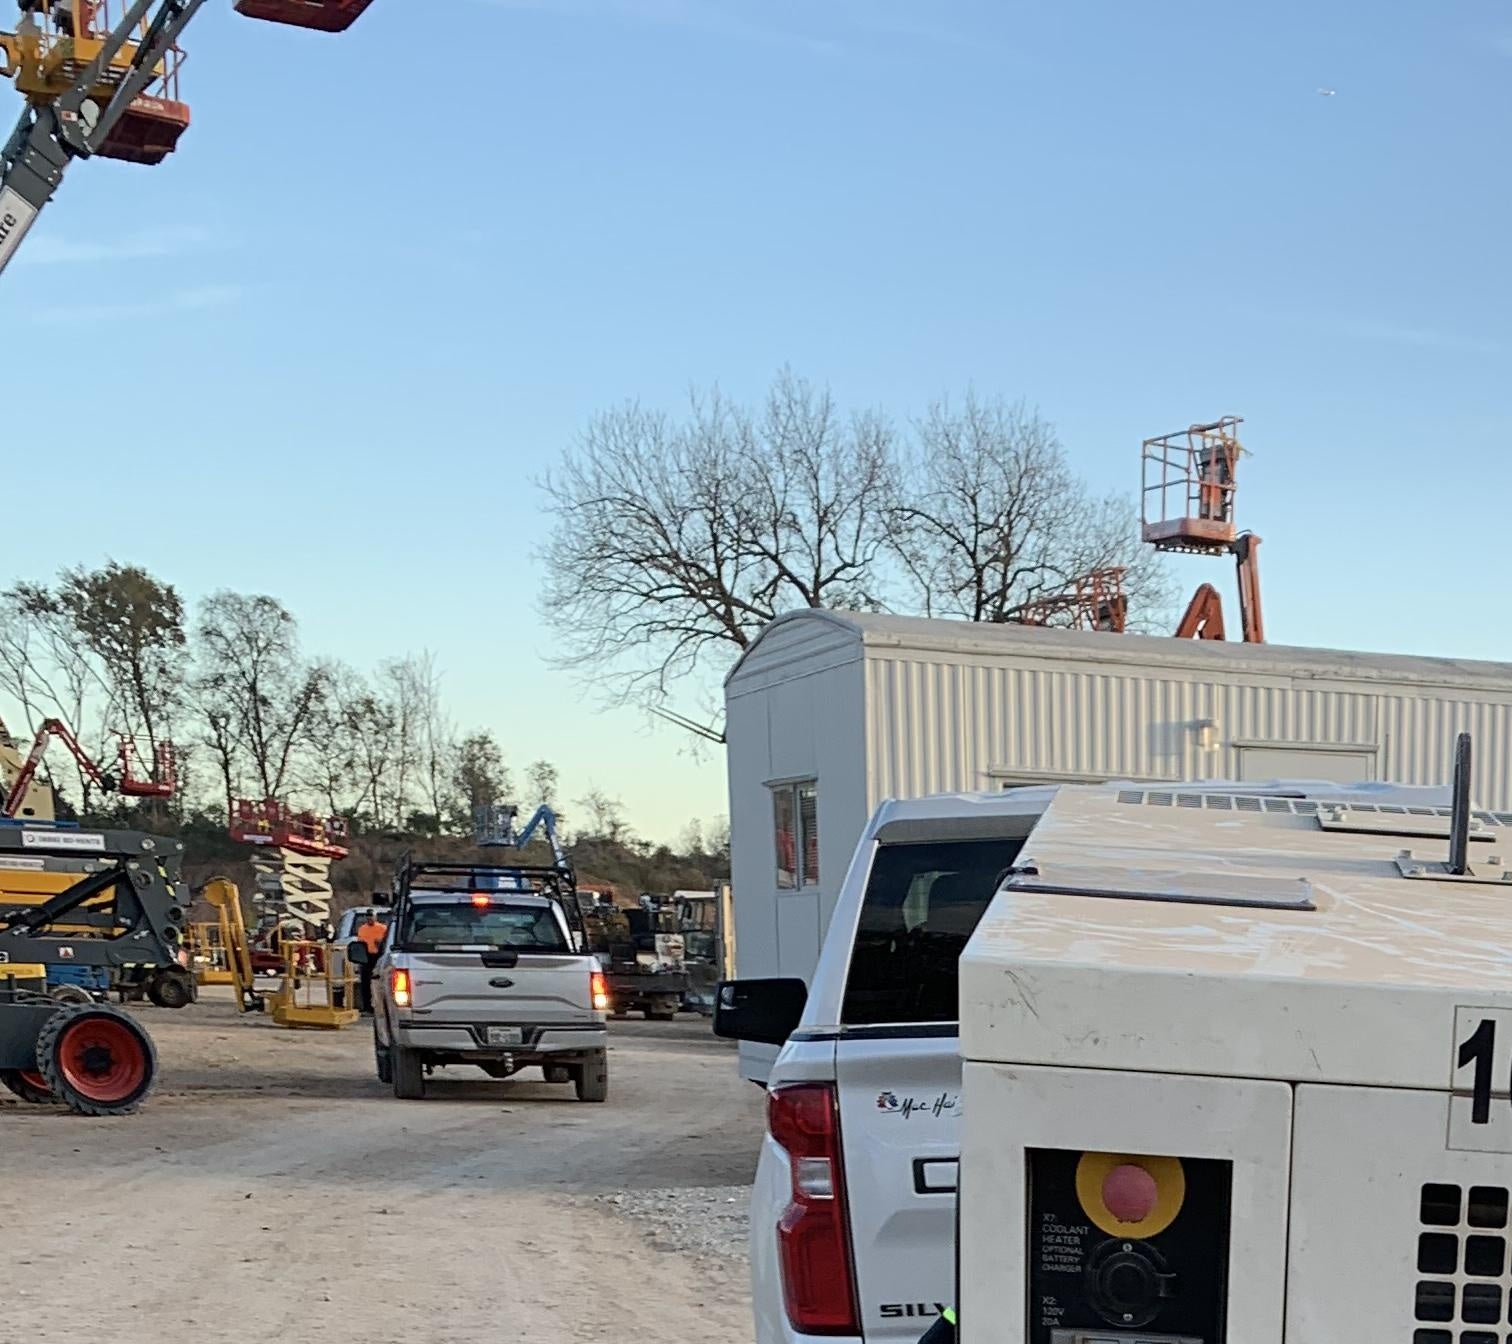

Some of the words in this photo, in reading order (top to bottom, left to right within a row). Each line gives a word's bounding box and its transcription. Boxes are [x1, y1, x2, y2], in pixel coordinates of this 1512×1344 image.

[1041, 1223, 1088, 1235] COOLANT
[1041, 1234, 1081, 1245] HEATER
[1041, 1244, 1085, 1256] OPTIONAL
[1041, 1254, 1081, 1264] BATTERY
[1041, 1262, 1082, 1273] CHARGER
